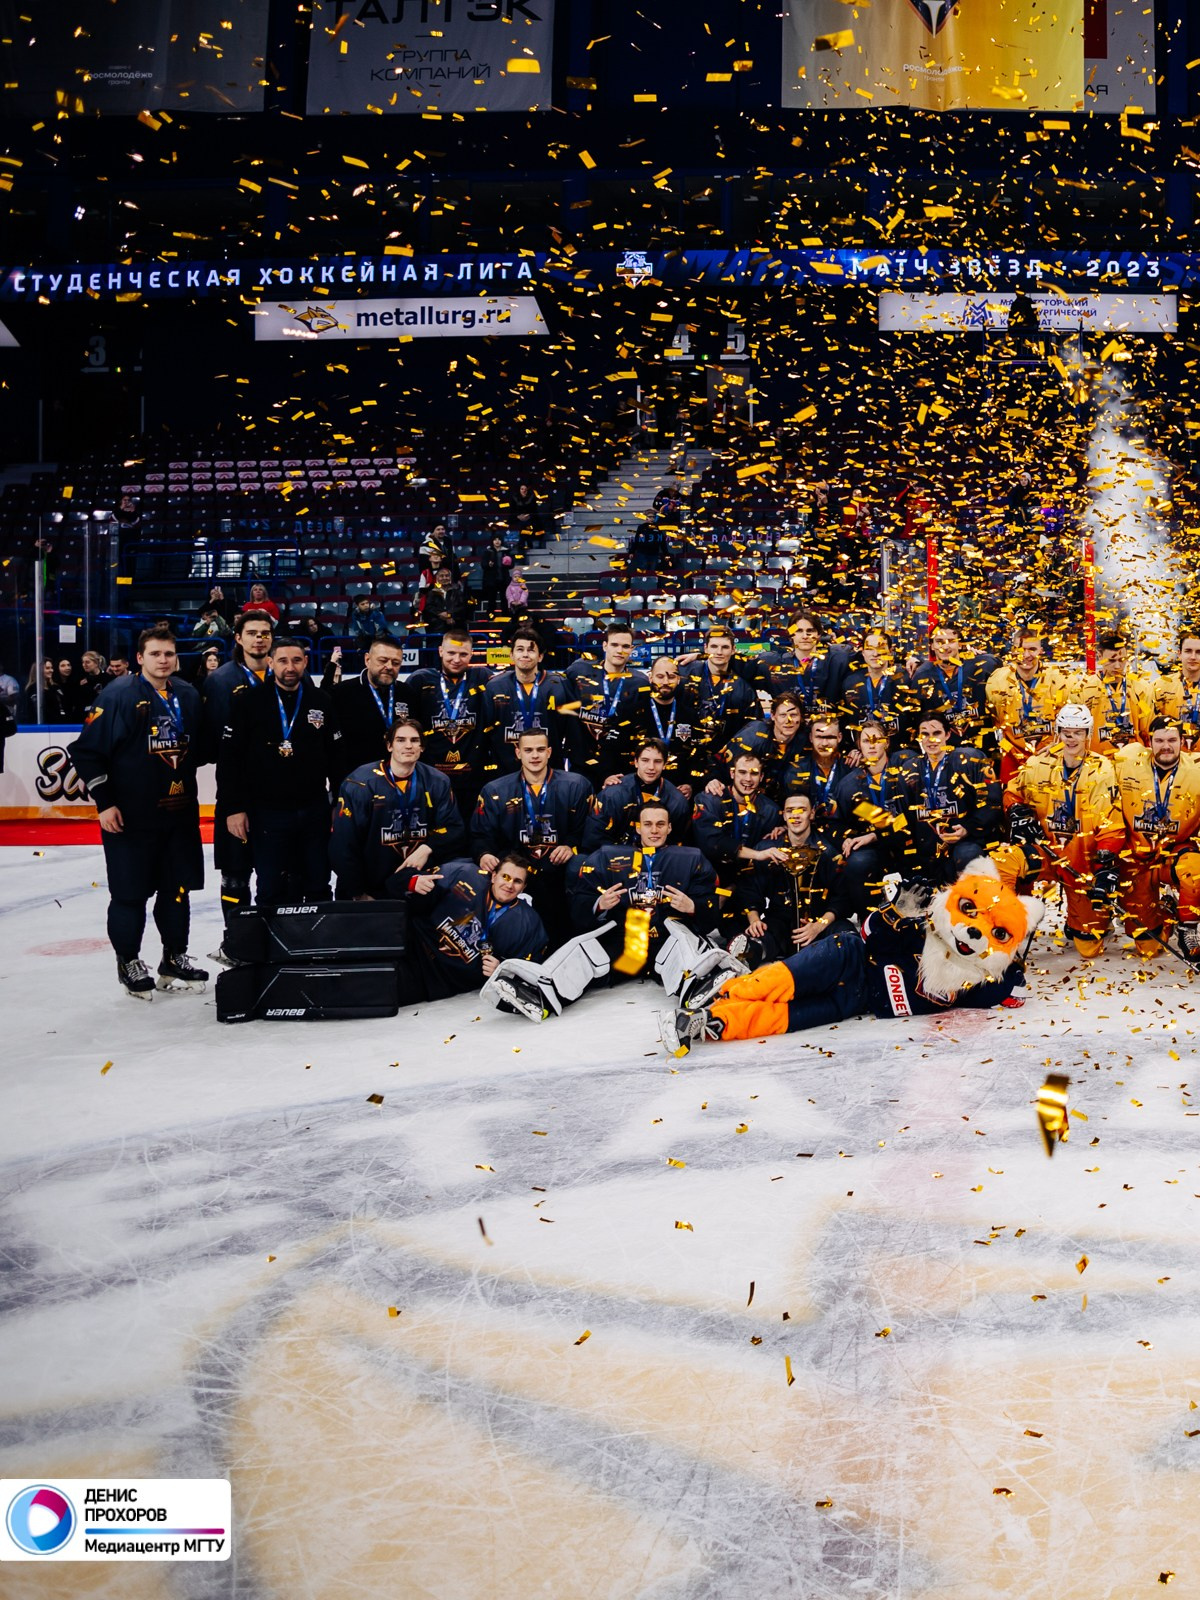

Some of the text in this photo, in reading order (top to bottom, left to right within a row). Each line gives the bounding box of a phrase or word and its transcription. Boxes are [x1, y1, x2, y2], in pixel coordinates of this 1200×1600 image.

[391, 49, 472, 62] ГРУППА
[370, 63, 491, 81] КОМПАНИЙ
[14, 261, 533, 294] СТУДЕНЧЕСКАЯ ХОККЕЙНАЯ ЛИГА
[852, 254, 1160, 279] МАТЧ ЗВЁЗД 2023
[1000, 299, 1089, 307] МАТОГОРСКИЙ
[356, 305, 512, 328] metallurg.ru
[727, 322, 745, 353] 5
[88, 335, 106, 366] 3
[277, 906, 319, 915] BAUER
[887, 967, 910, 1016] FONBET
[266, 1008, 306, 1016] BAUER
